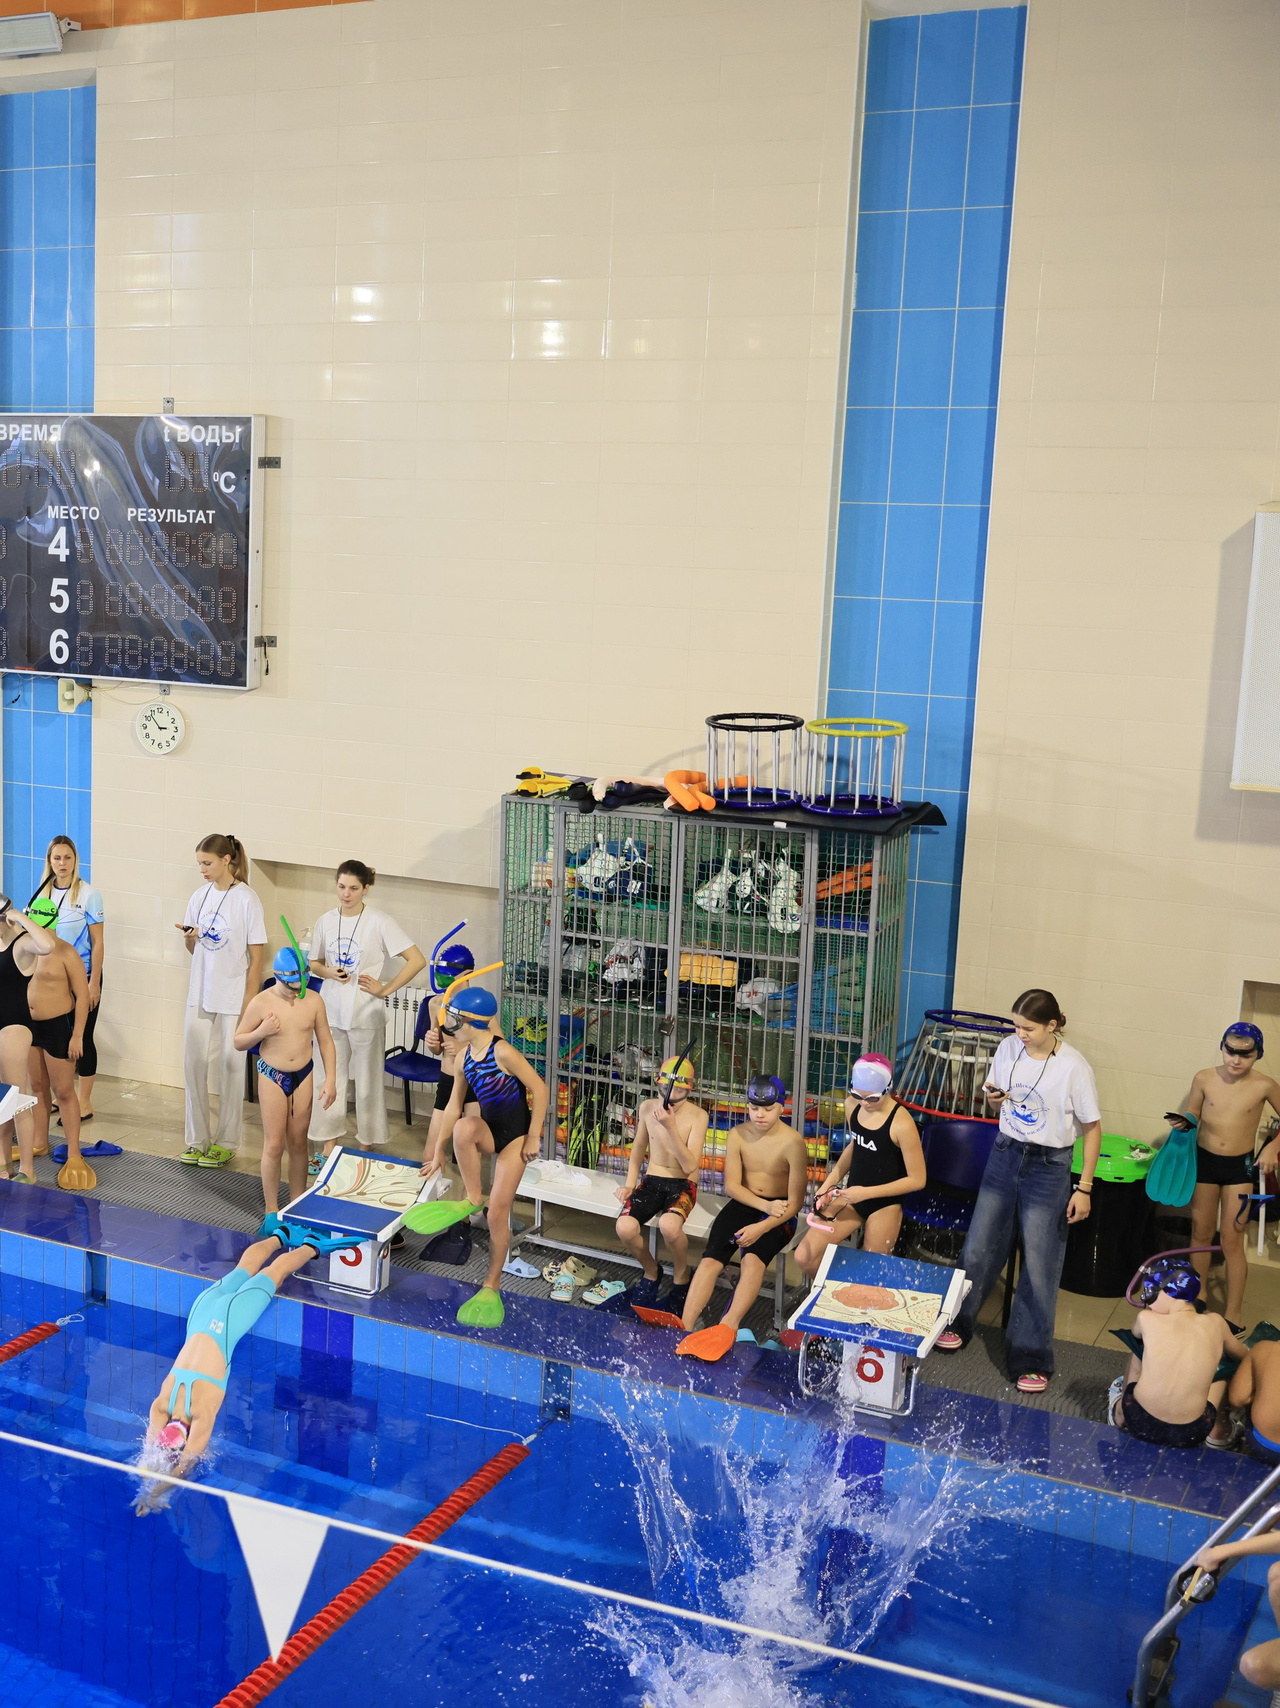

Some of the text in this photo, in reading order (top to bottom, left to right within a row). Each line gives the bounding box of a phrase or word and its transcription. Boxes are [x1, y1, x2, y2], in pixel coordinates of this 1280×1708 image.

[164, 426, 240, 446] t ВОДЫ
[48, 505, 215, 524] МЕСТО РЕЗУЛЬТАТ
[48, 527, 69, 562] 4
[49, 578, 69, 613] 5
[49, 629, 69, 664] 6
[856, 1346, 885, 1383] 6
